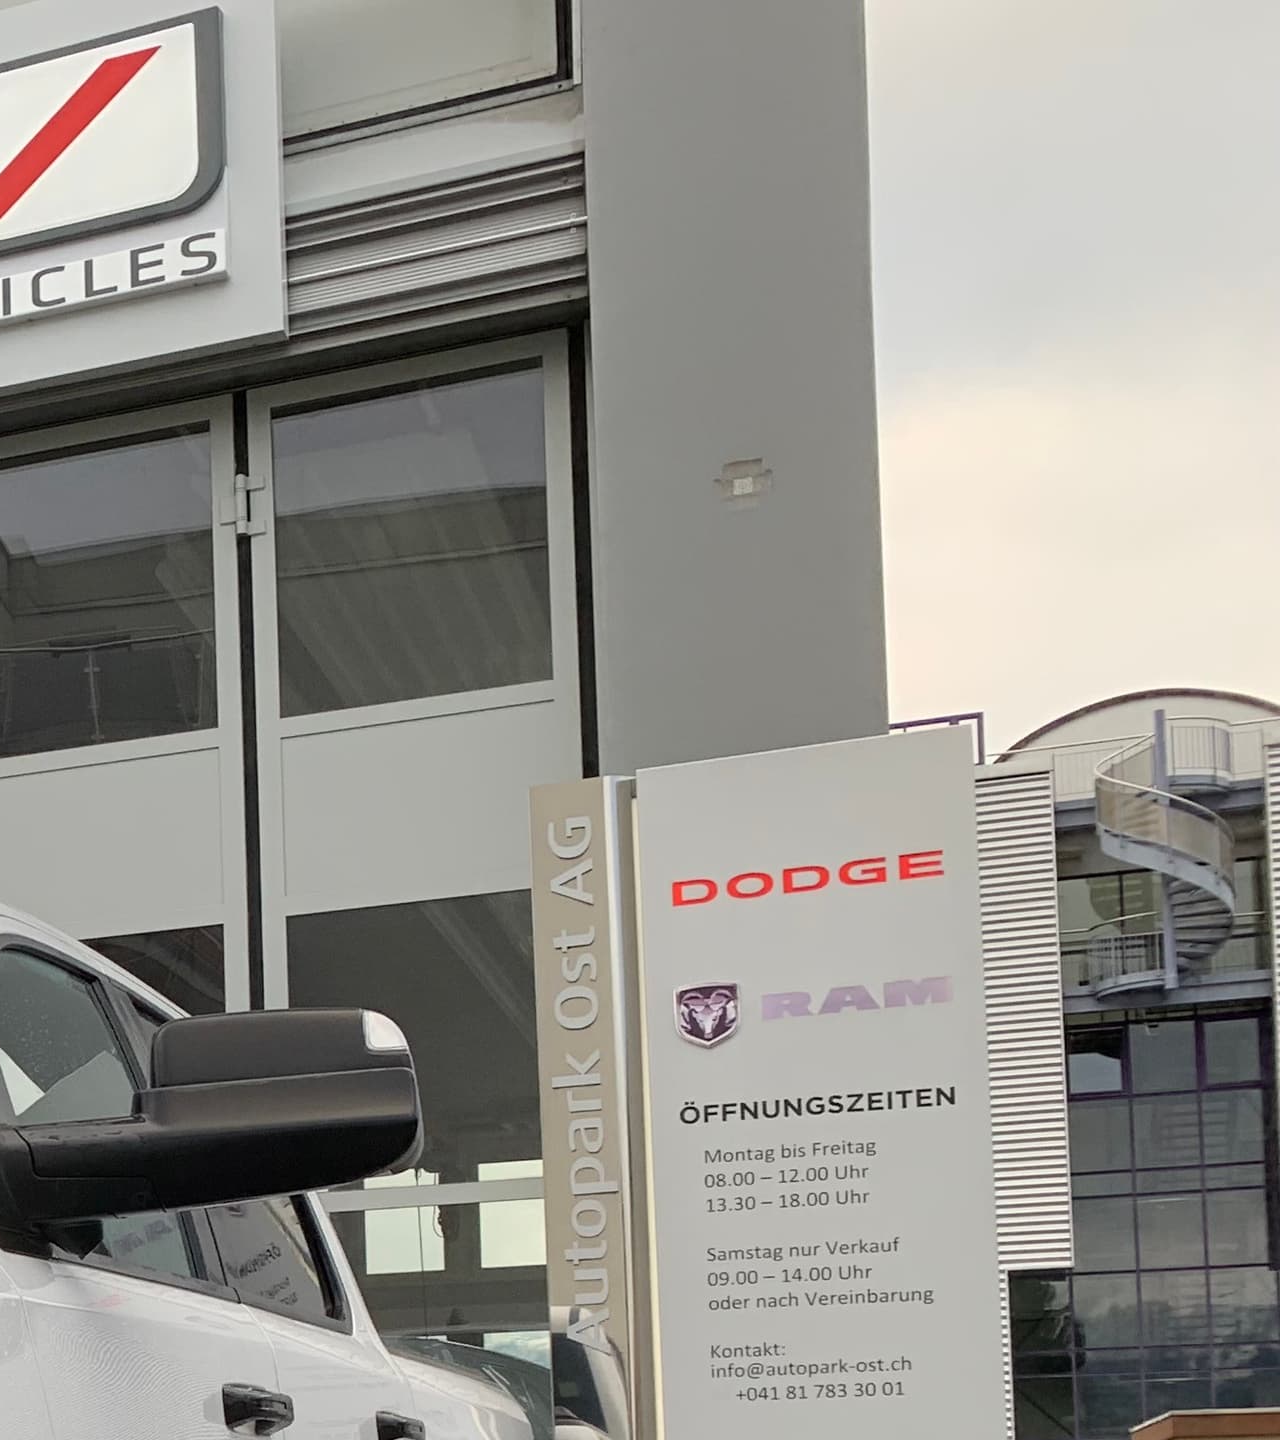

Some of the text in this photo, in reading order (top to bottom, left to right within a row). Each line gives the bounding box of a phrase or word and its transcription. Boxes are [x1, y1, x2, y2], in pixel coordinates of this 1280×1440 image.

[671, 849, 945, 906] DODGE
[762, 976, 953, 1020] RAM
[548, 814, 619, 1356] Autopark Ost AG
[679, 1085, 956, 1125] ÖFFNUNGSZEITEN
[704, 1140, 877, 1164] Montag bis Freitag
[704, 1171, 756, 1189] 08.00
[778, 1166, 829, 1184] 12.00
[834, 1164, 869, 1180] Uhr
[706, 1195, 756, 1213] 13.30
[779, 1191, 830, 1209] 18.00
[835, 1189, 870, 1205] Uhr
[706, 1236, 900, 1263] Samstag nur Verkauf
[707, 1270, 759, 1287] 09.00
[781, 1266, 833, 1283] 14.00
[838, 1264, 873, 1281] Uhr
[708, 1288, 935, 1311] oder nach Vereinbarung
[710, 1341, 786, 1359] Kontakt:
[711, 1355, 912, 1380] info@autopark-ost.ch
[735, 1381, 905, 1402] +041 81 783 30 01
